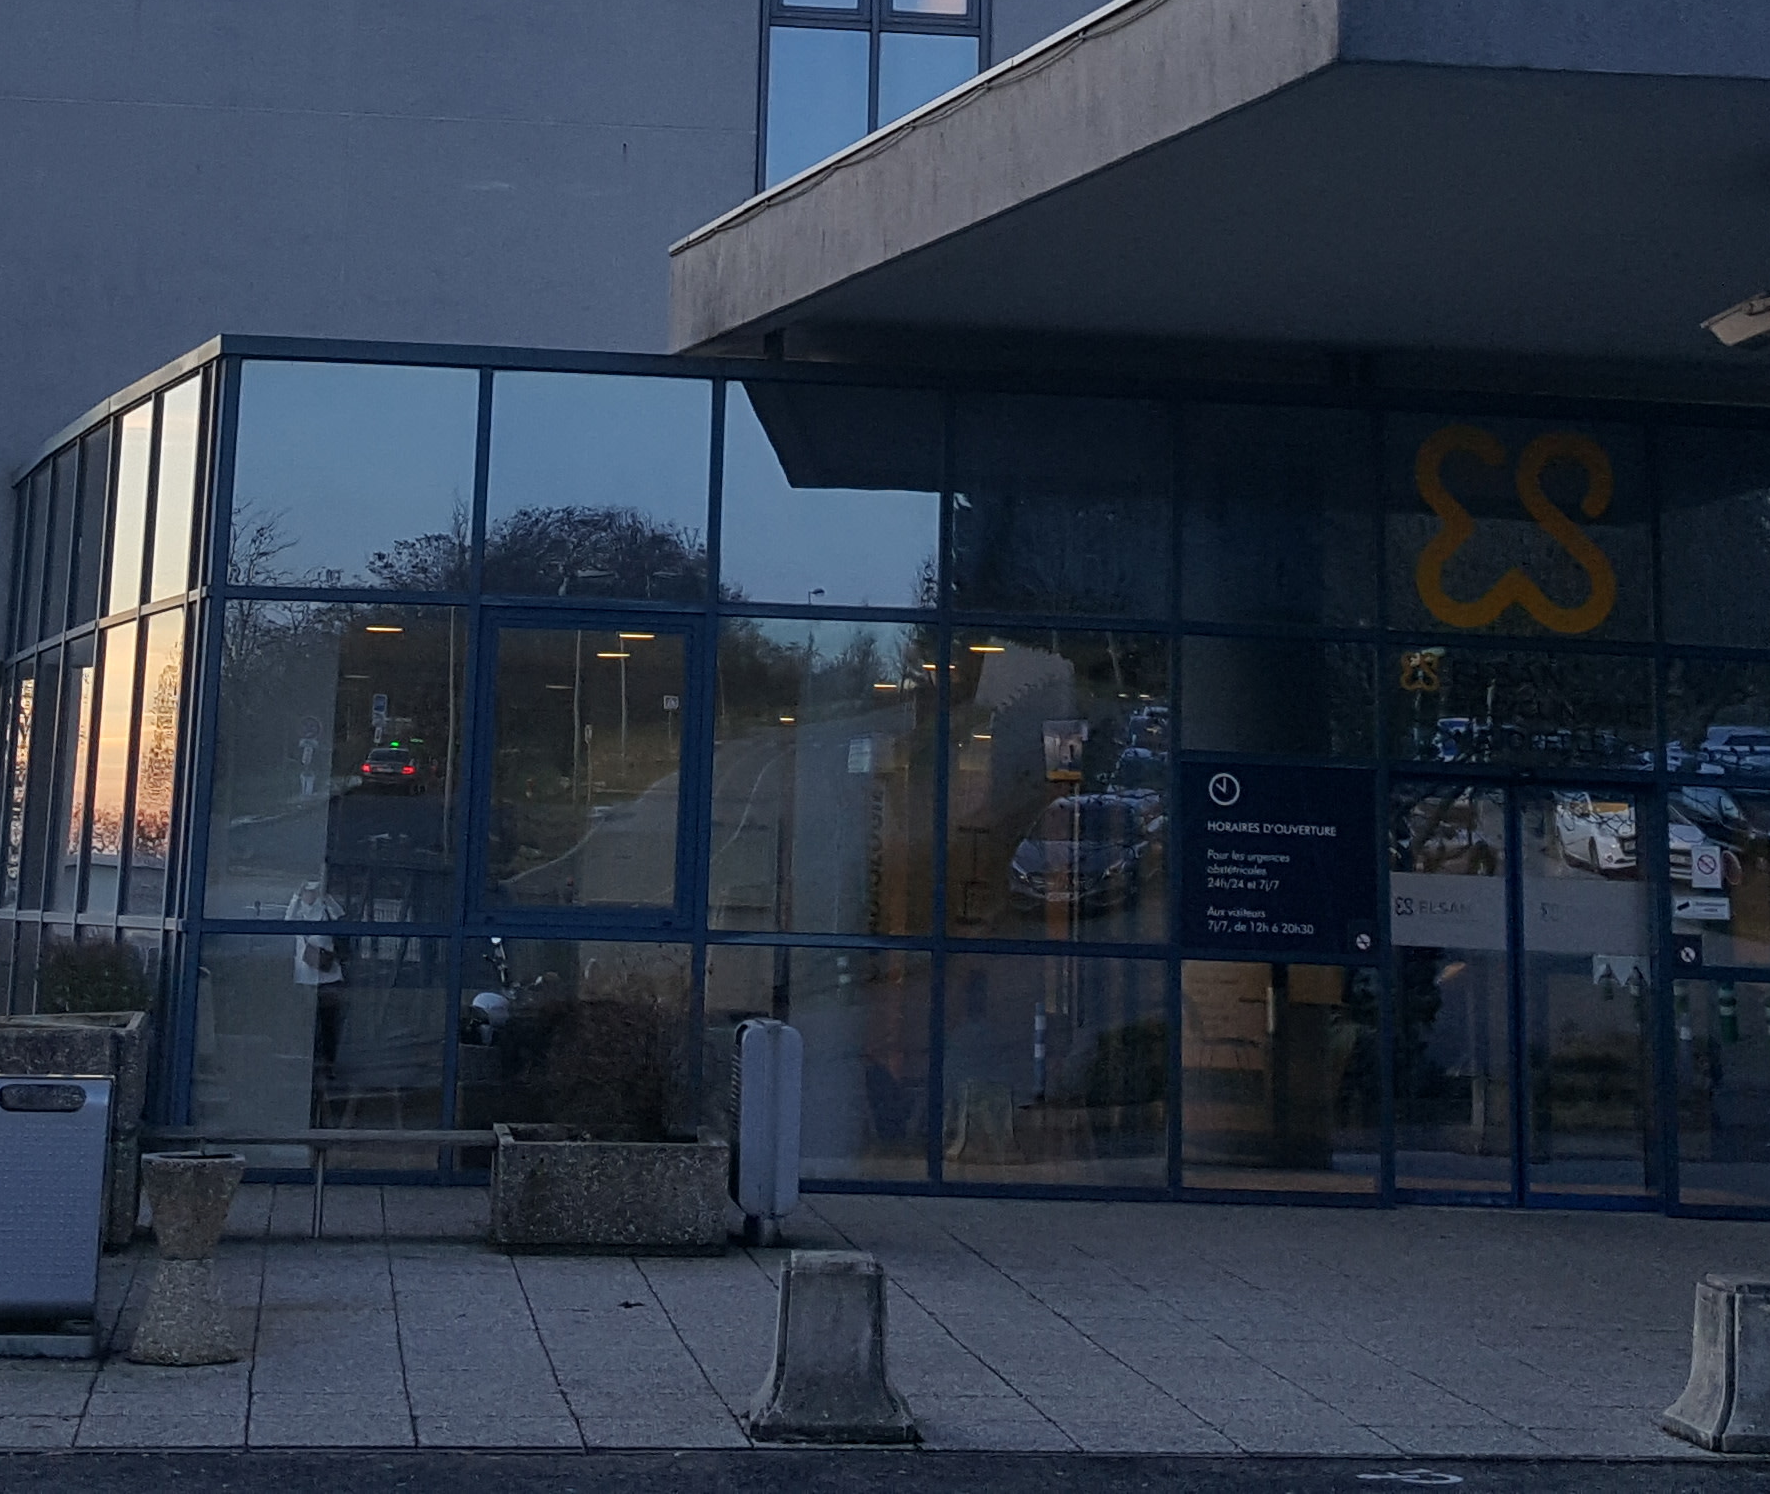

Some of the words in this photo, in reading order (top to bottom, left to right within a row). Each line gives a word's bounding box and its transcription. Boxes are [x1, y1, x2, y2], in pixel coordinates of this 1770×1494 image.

[1208, 821, 1260, 833] HORAIRES
[1263, 823, 1336, 836] D'OUVERTURE
[1207, 849, 1230, 861] Pour
[1232, 850, 1245, 861] les
[1247, 853, 1290, 864] urgences
[1207, 877, 1244, 890] 24h/24
[1247, 880, 1257, 890] et
[1207, 906, 1225, 917] Aux
[1228, 907, 1266, 918] visiteurs
[1234, 922, 1247, 933] de
[1249, 921, 1270, 933] 12h
[1282, 923, 1313, 935] 20h30
